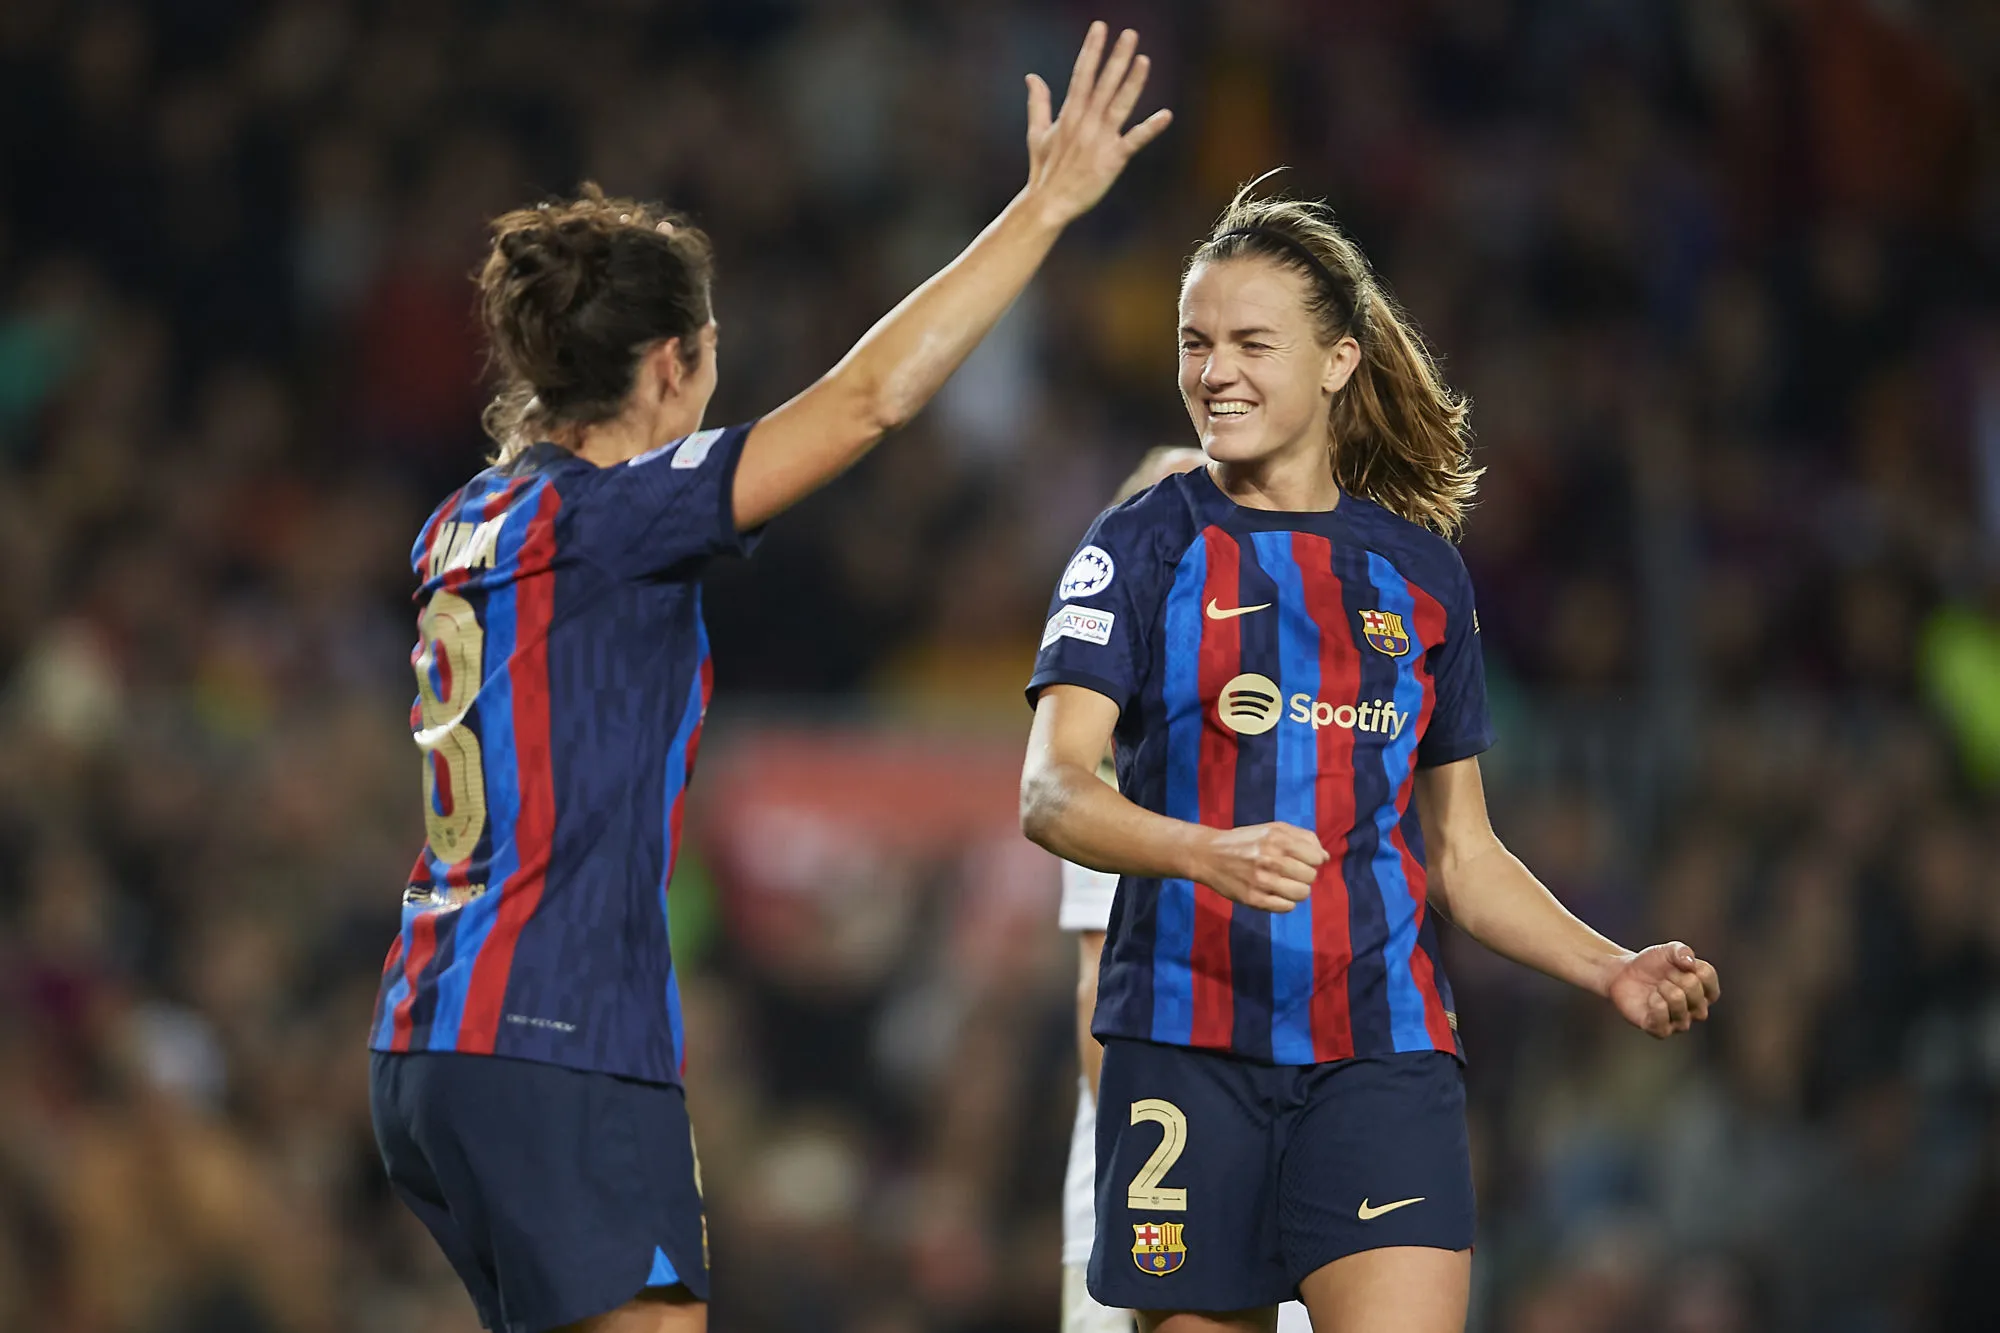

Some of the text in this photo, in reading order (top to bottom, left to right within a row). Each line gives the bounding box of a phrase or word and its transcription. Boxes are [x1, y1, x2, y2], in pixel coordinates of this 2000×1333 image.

[415, 589, 486, 865] 8
[1289, 692, 1408, 740] Spotify
[1127, 1098, 1187, 1211] 2
[1148, 1244, 1170, 1253] FCB
